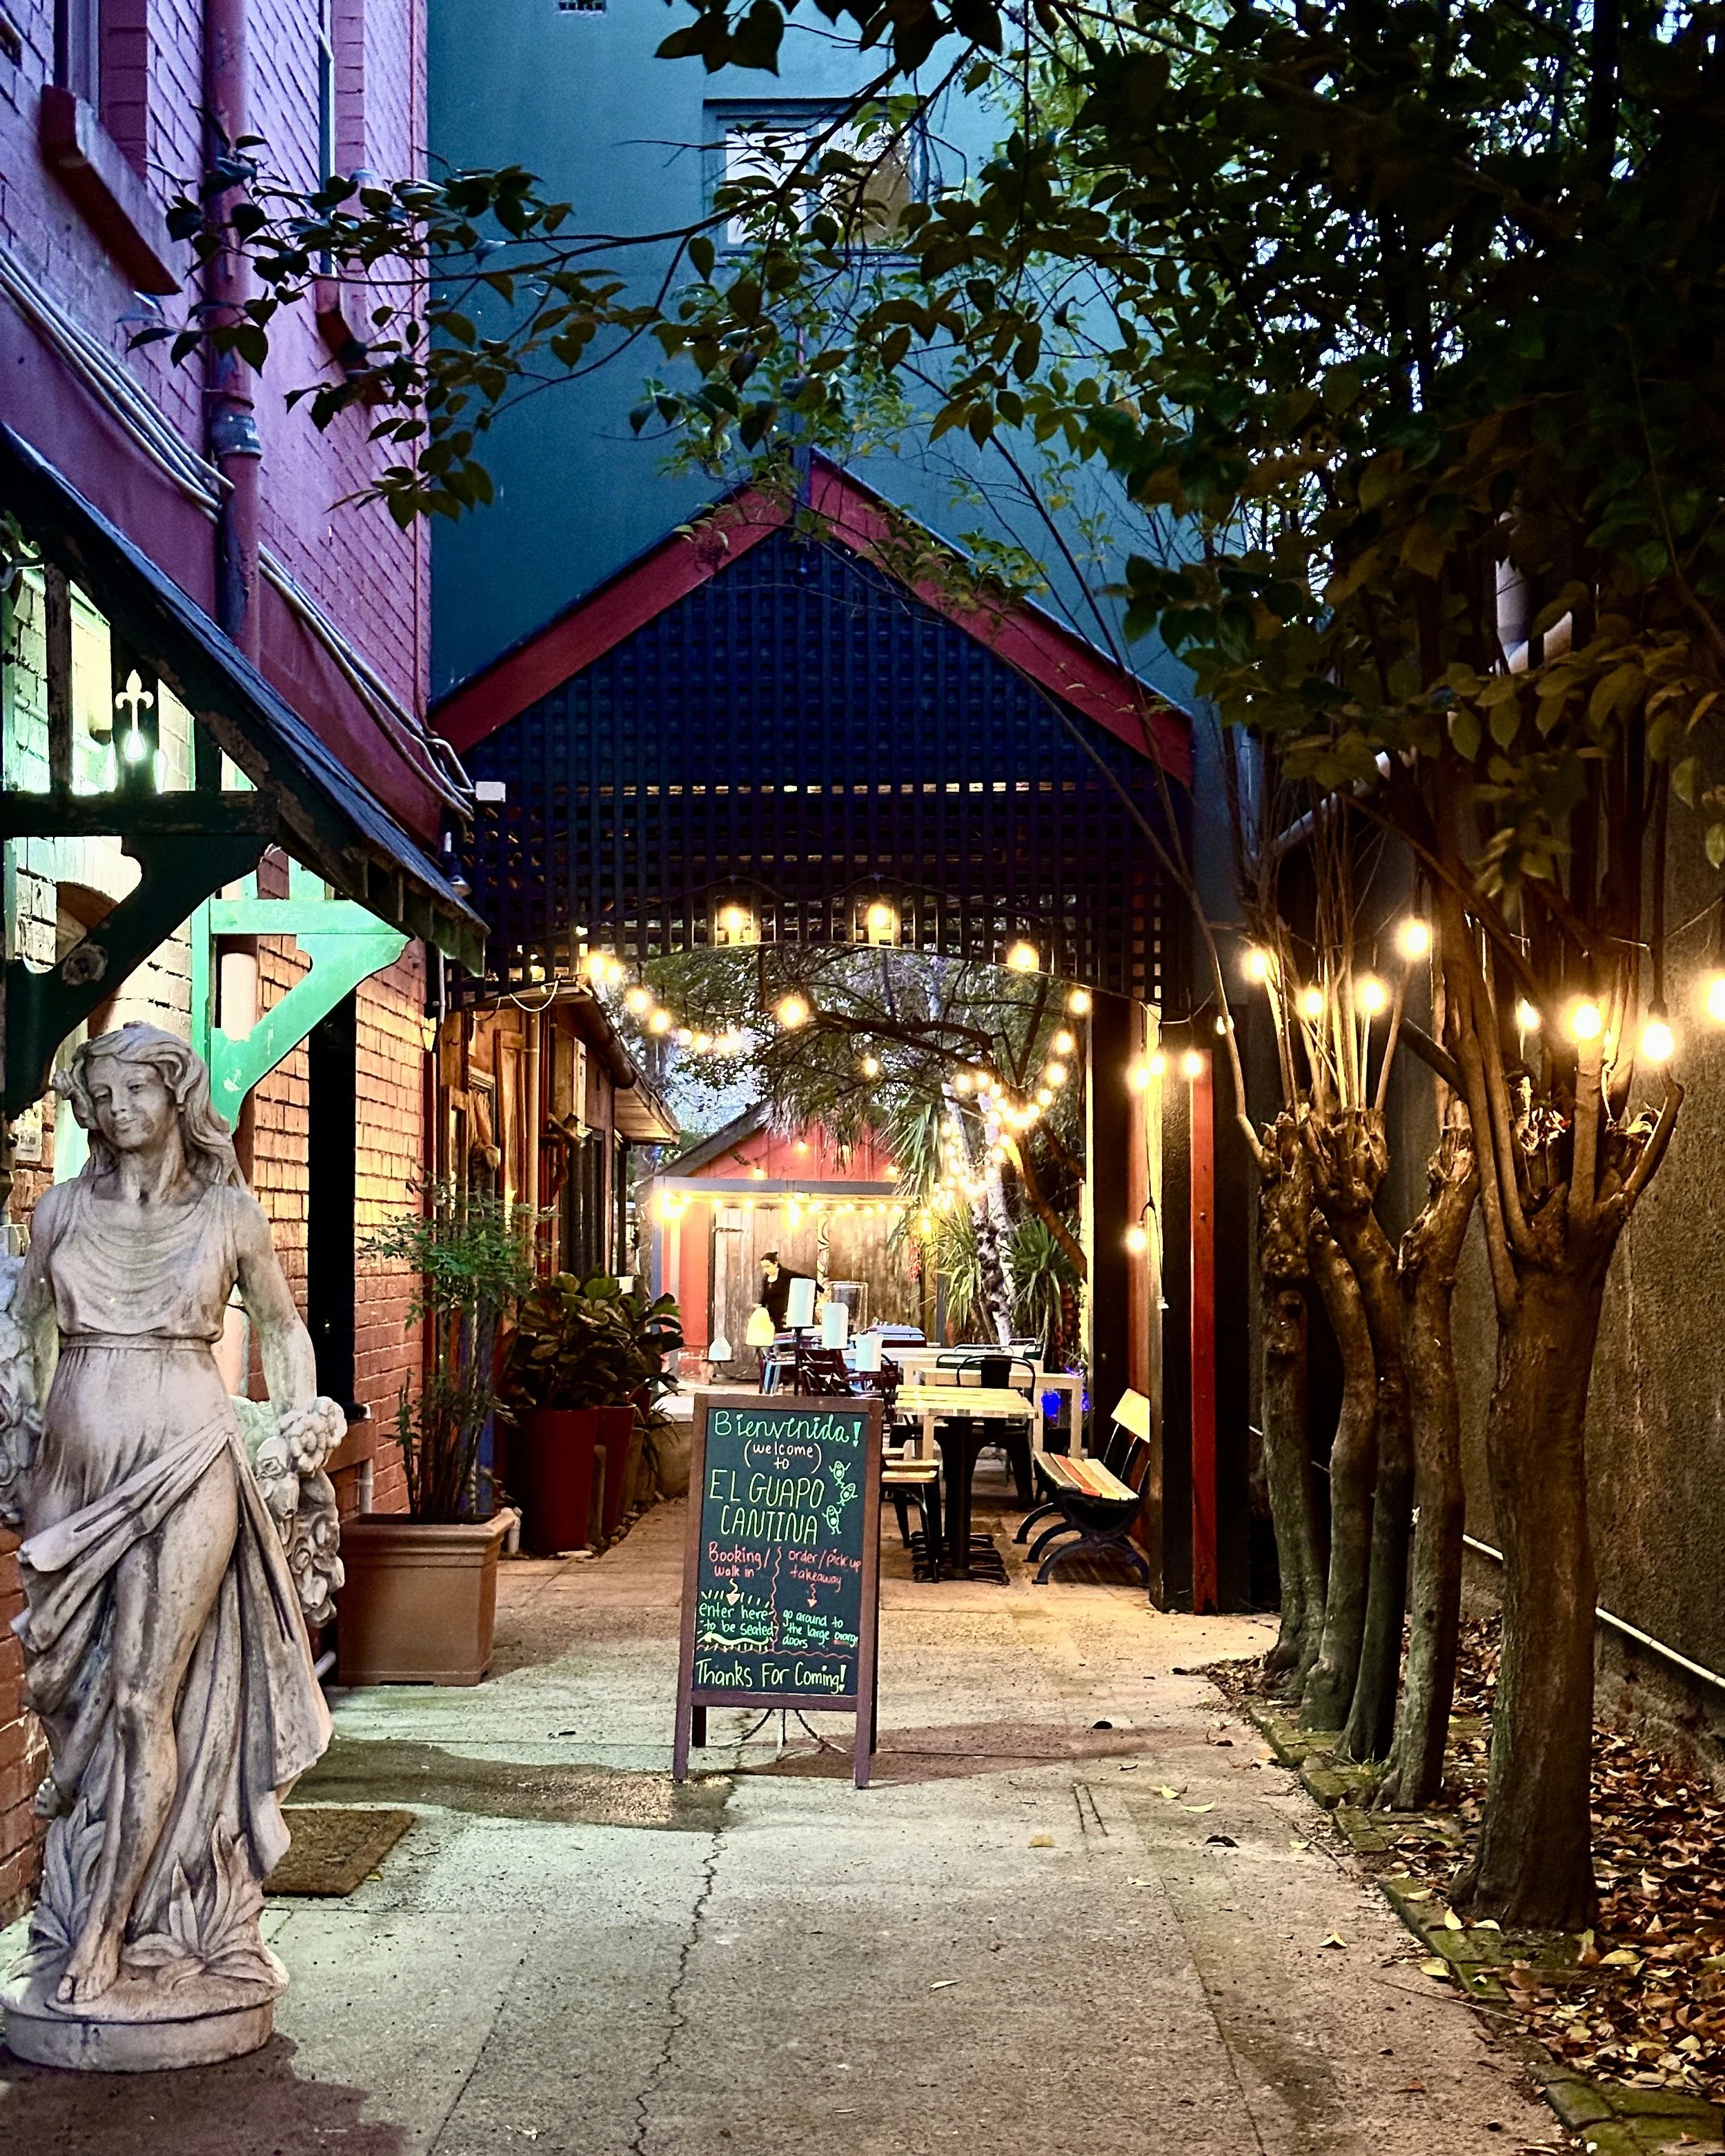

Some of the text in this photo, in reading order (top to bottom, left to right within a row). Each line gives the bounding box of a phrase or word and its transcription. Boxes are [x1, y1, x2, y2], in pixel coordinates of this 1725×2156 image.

[709, 1469, 825, 1509] EL GUAPO
[720, 1505, 818, 1545] CANTINA
[745, 1567, 754, 1577] in
[849, 1558, 862, 1573] up
[790, 1564, 842, 1593] takeaway
[699, 1602, 768, 1621] enter here
[782, 1609, 843, 1629] go around to
[703, 1619, 716, 1630] to
[721, 1620, 736, 1633] be
[787, 1622, 802, 1635] the
[807, 1624, 830, 1645] large
[782, 1634, 808, 1649] doors
[696, 1658, 847, 1694] Thanks For Coming!
